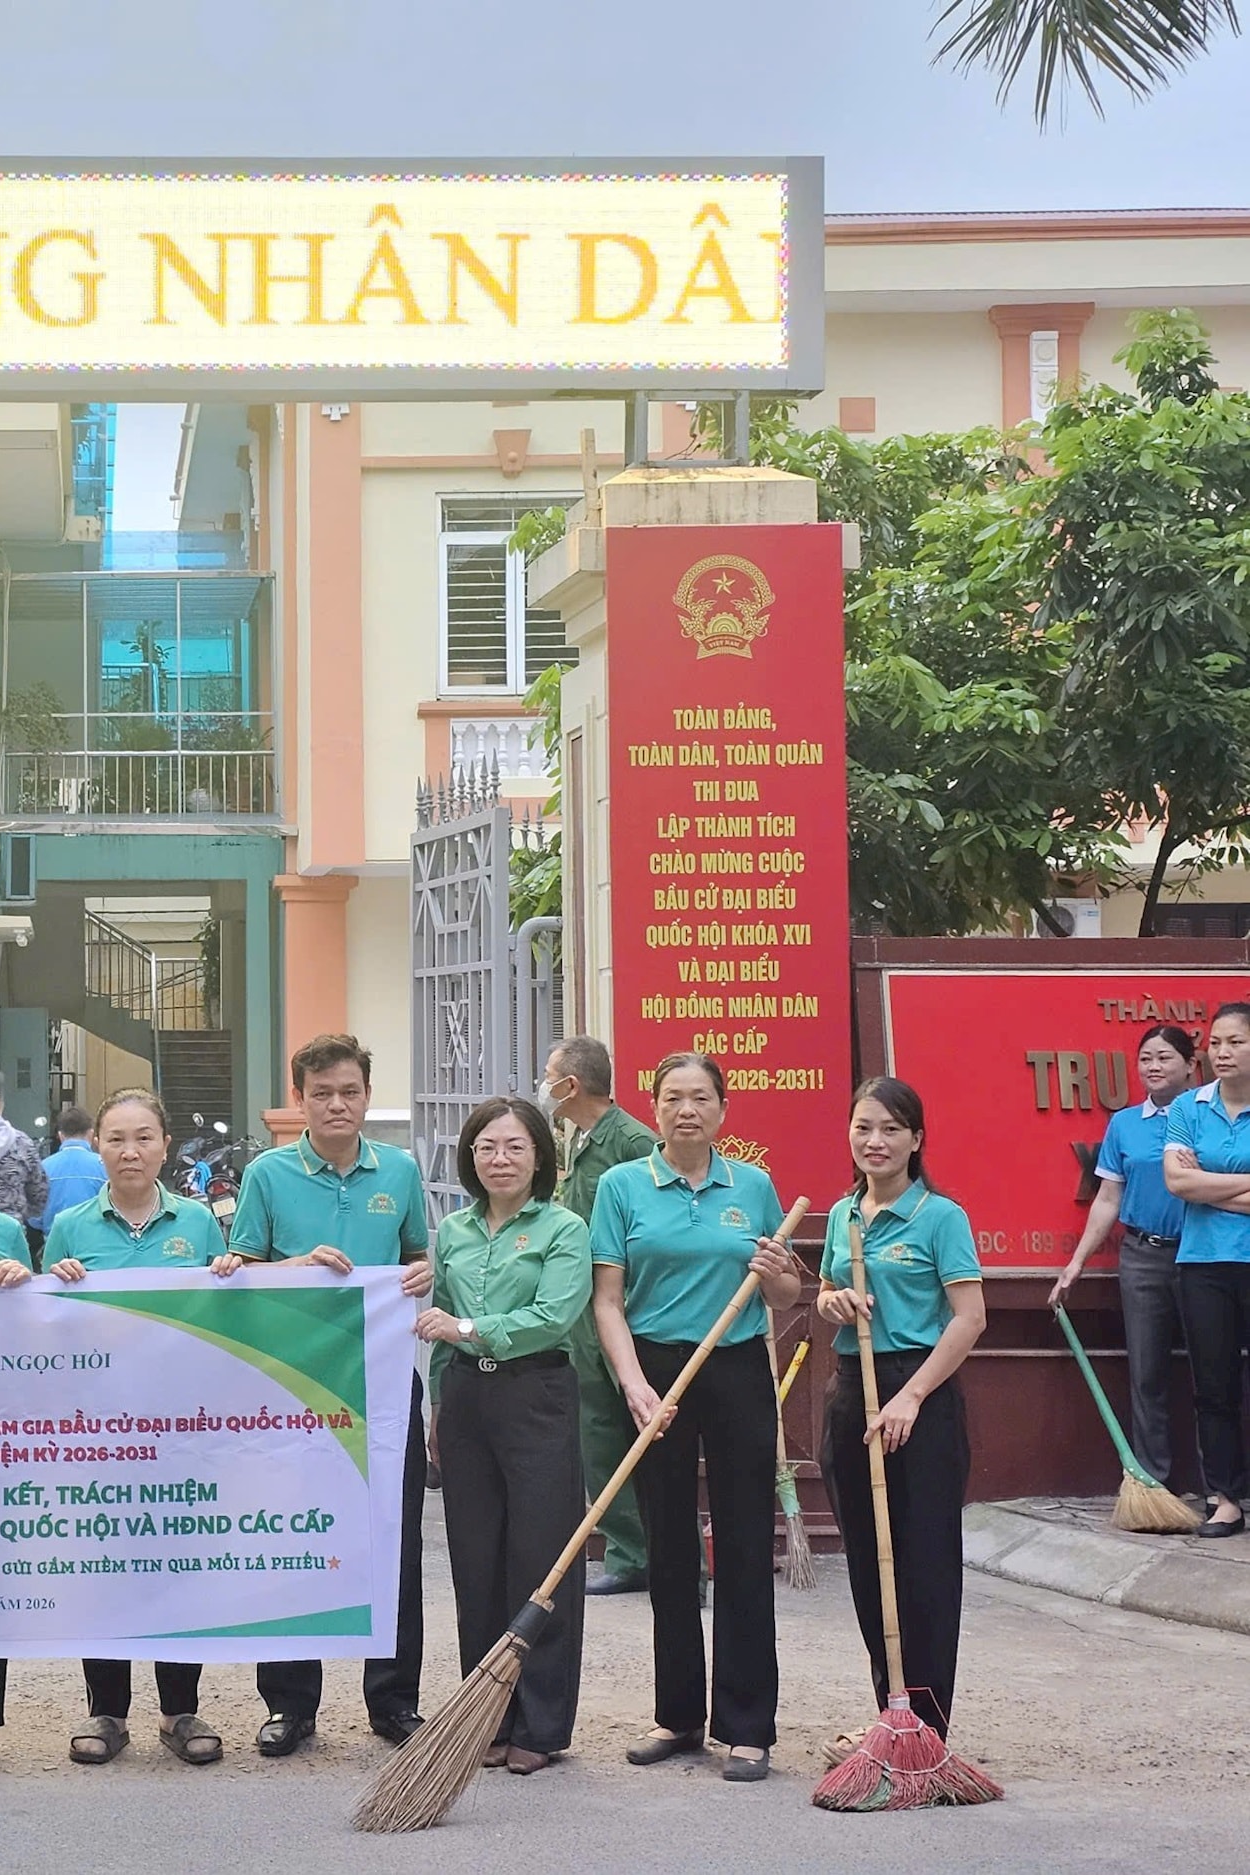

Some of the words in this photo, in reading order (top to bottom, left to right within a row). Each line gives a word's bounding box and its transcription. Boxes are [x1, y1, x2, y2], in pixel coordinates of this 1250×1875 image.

[141, 202, 530, 328] NHÂN
[673, 705, 719, 730] TOÀN
[724, 702, 777, 732] ĐẢNG,
[628, 741, 674, 766] TOÀN
[679, 741, 720, 768] DÂN,
[725, 740, 770, 766] TOÀN
[775, 739, 823, 767] QUÂN
[693, 780, 720, 802] THI
[725, 780, 759, 802] ĐUA
[657, 813, 690, 842] LẬP
[695, 812, 752, 838] THÀNH
[757, 812, 796, 837] TÍCH
[649, 848, 696, 874] CHÀO
[701, 848, 753, 873] MỪNG
[758, 848, 805, 878] CUỘC
[654, 882, 689, 911] BẦU
[694, 882, 719, 910] CỬ
[722, 888, 751, 914] ĐẠI
[756, 880, 796, 909] BIỂU
[646, 918, 692, 948] QUỐC
[698, 921, 726, 950] HỘI
[731, 920, 779, 946] KHÓA
[783, 924, 812, 945] XVI
[678, 957, 702, 982] VÀ
[706, 960, 735, 986] ĐẠI
[740, 952, 780, 982] BIỂU
[641, 994, 670, 1023] HỘI
[675, 990, 724, 1018] ĐỒNG
[728, 992, 777, 1018] NHÂN
[782, 992, 818, 1017] DÂN
[1098, 992, 1207, 1022] THÀNH
[693, 1029, 728, 1054] CÁC
[733, 1025, 768, 1054] CẤP
[726, 1069, 824, 1091] 2026-2031!
[1, 1353, 65, 1375] NGỌC
[22, 1419, 56, 1435] GIA
[59, 1408, 101, 1434] BẦU
[105, 1412, 134, 1433] CỬ
[136, 1417, 172, 1438] ĐẠI
[175, 1406, 222, 1432] BIỂU
[226, 1405, 283, 1433] QUỐC
[286, 1407, 324, 1435] HỘI
[327, 1407, 354, 1429] VÀ
[33, 1440, 60, 1463] KỲ
[63, 1445, 158, 1462] 2026-2031
[3, 1480, 50, 1509] KẾT,
[56, 1480, 132, 1505] TRÁCH
[139, 1478, 218, 1507] NHIỆM
[0, 1513, 69, 1543] QUỐC
[75, 1513, 120, 1542] HỘI
[125, 1512, 157, 1537] VÀ
[162, 1514, 232, 1536] HĐND
[238, 1509, 283, 1534] CÁC
[290, 1508, 335, 1534] CẤP
[131, 1558, 163, 1574] TIN
[168, 1557, 203, 1573] QUA
[245, 1553, 266, 1570] LÁ
[25, 1598, 56, 1610] 2026
